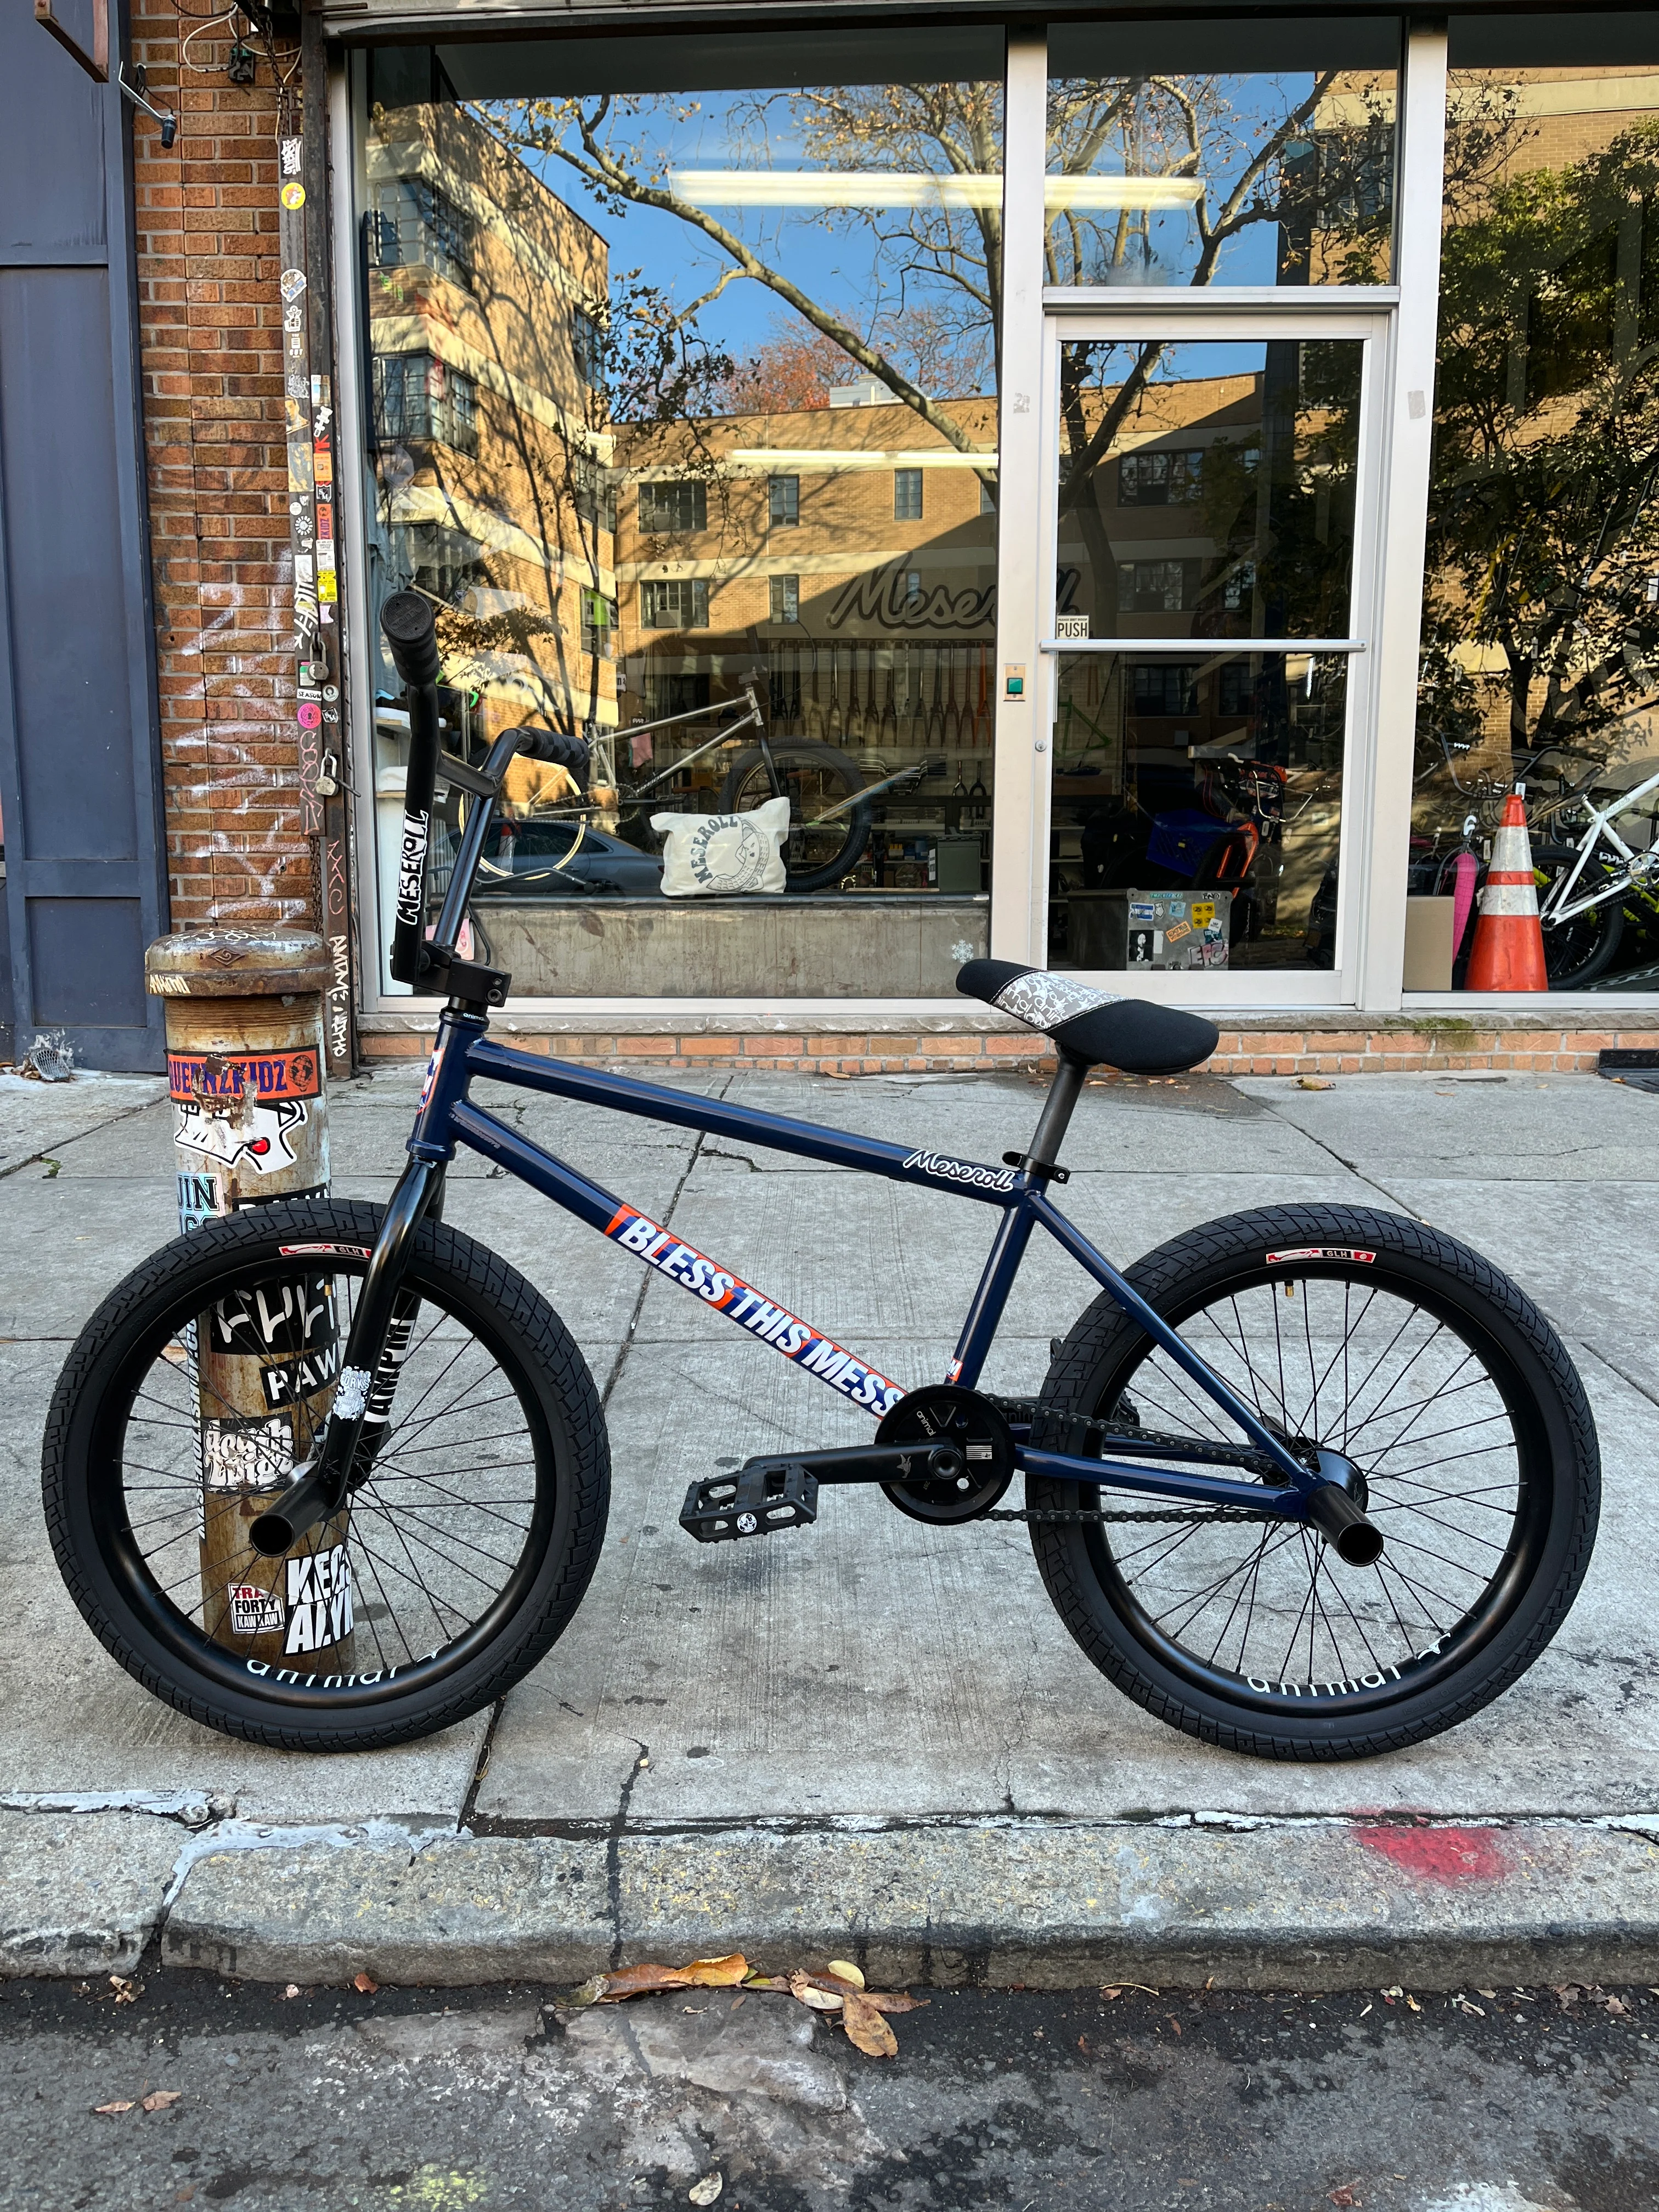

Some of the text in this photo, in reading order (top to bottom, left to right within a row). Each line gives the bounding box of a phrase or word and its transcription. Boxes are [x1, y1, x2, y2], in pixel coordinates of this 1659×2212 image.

[1058, 623, 1087, 637] PUSH
[691, 816, 738, 884] MESEROLL
[397, 810, 428, 925] MESEROLL
[902, 1149, 1015, 1192] Meseroll
[340, 1246, 360, 1256] GLH
[1327, 1250, 1347, 1259] GLH
[618, 1217, 907, 1417] BLESS THIS MESS
[917, 1410, 936, 1437] animal
[235, 1599, 276, 1613] FORTY
[238, 1612, 278, 1628] KAW KAW
[247, 1658, 399, 1689] animal
[1246, 1665, 1402, 1697] animal
